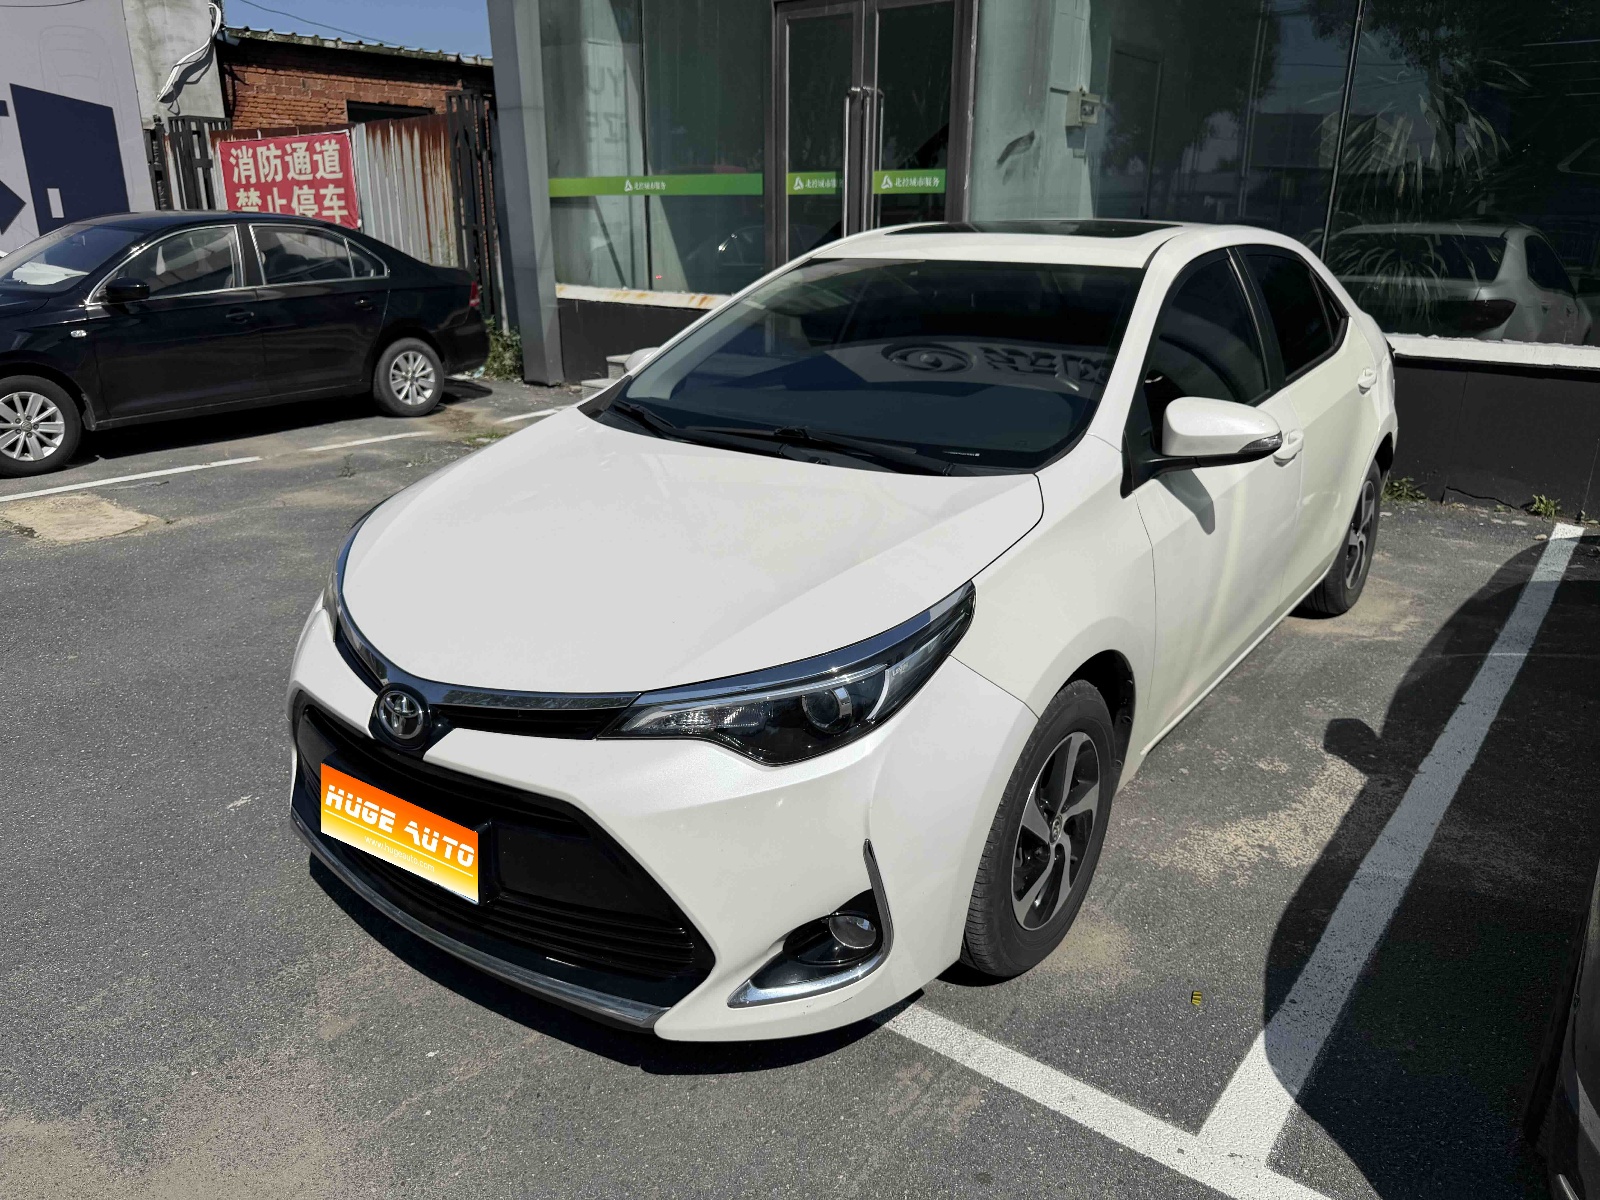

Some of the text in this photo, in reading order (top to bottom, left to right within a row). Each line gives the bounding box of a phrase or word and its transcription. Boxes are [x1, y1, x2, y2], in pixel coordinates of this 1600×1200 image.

[229, 139, 344, 184] 消防通道
[235, 183, 349, 224] 禁止停车
